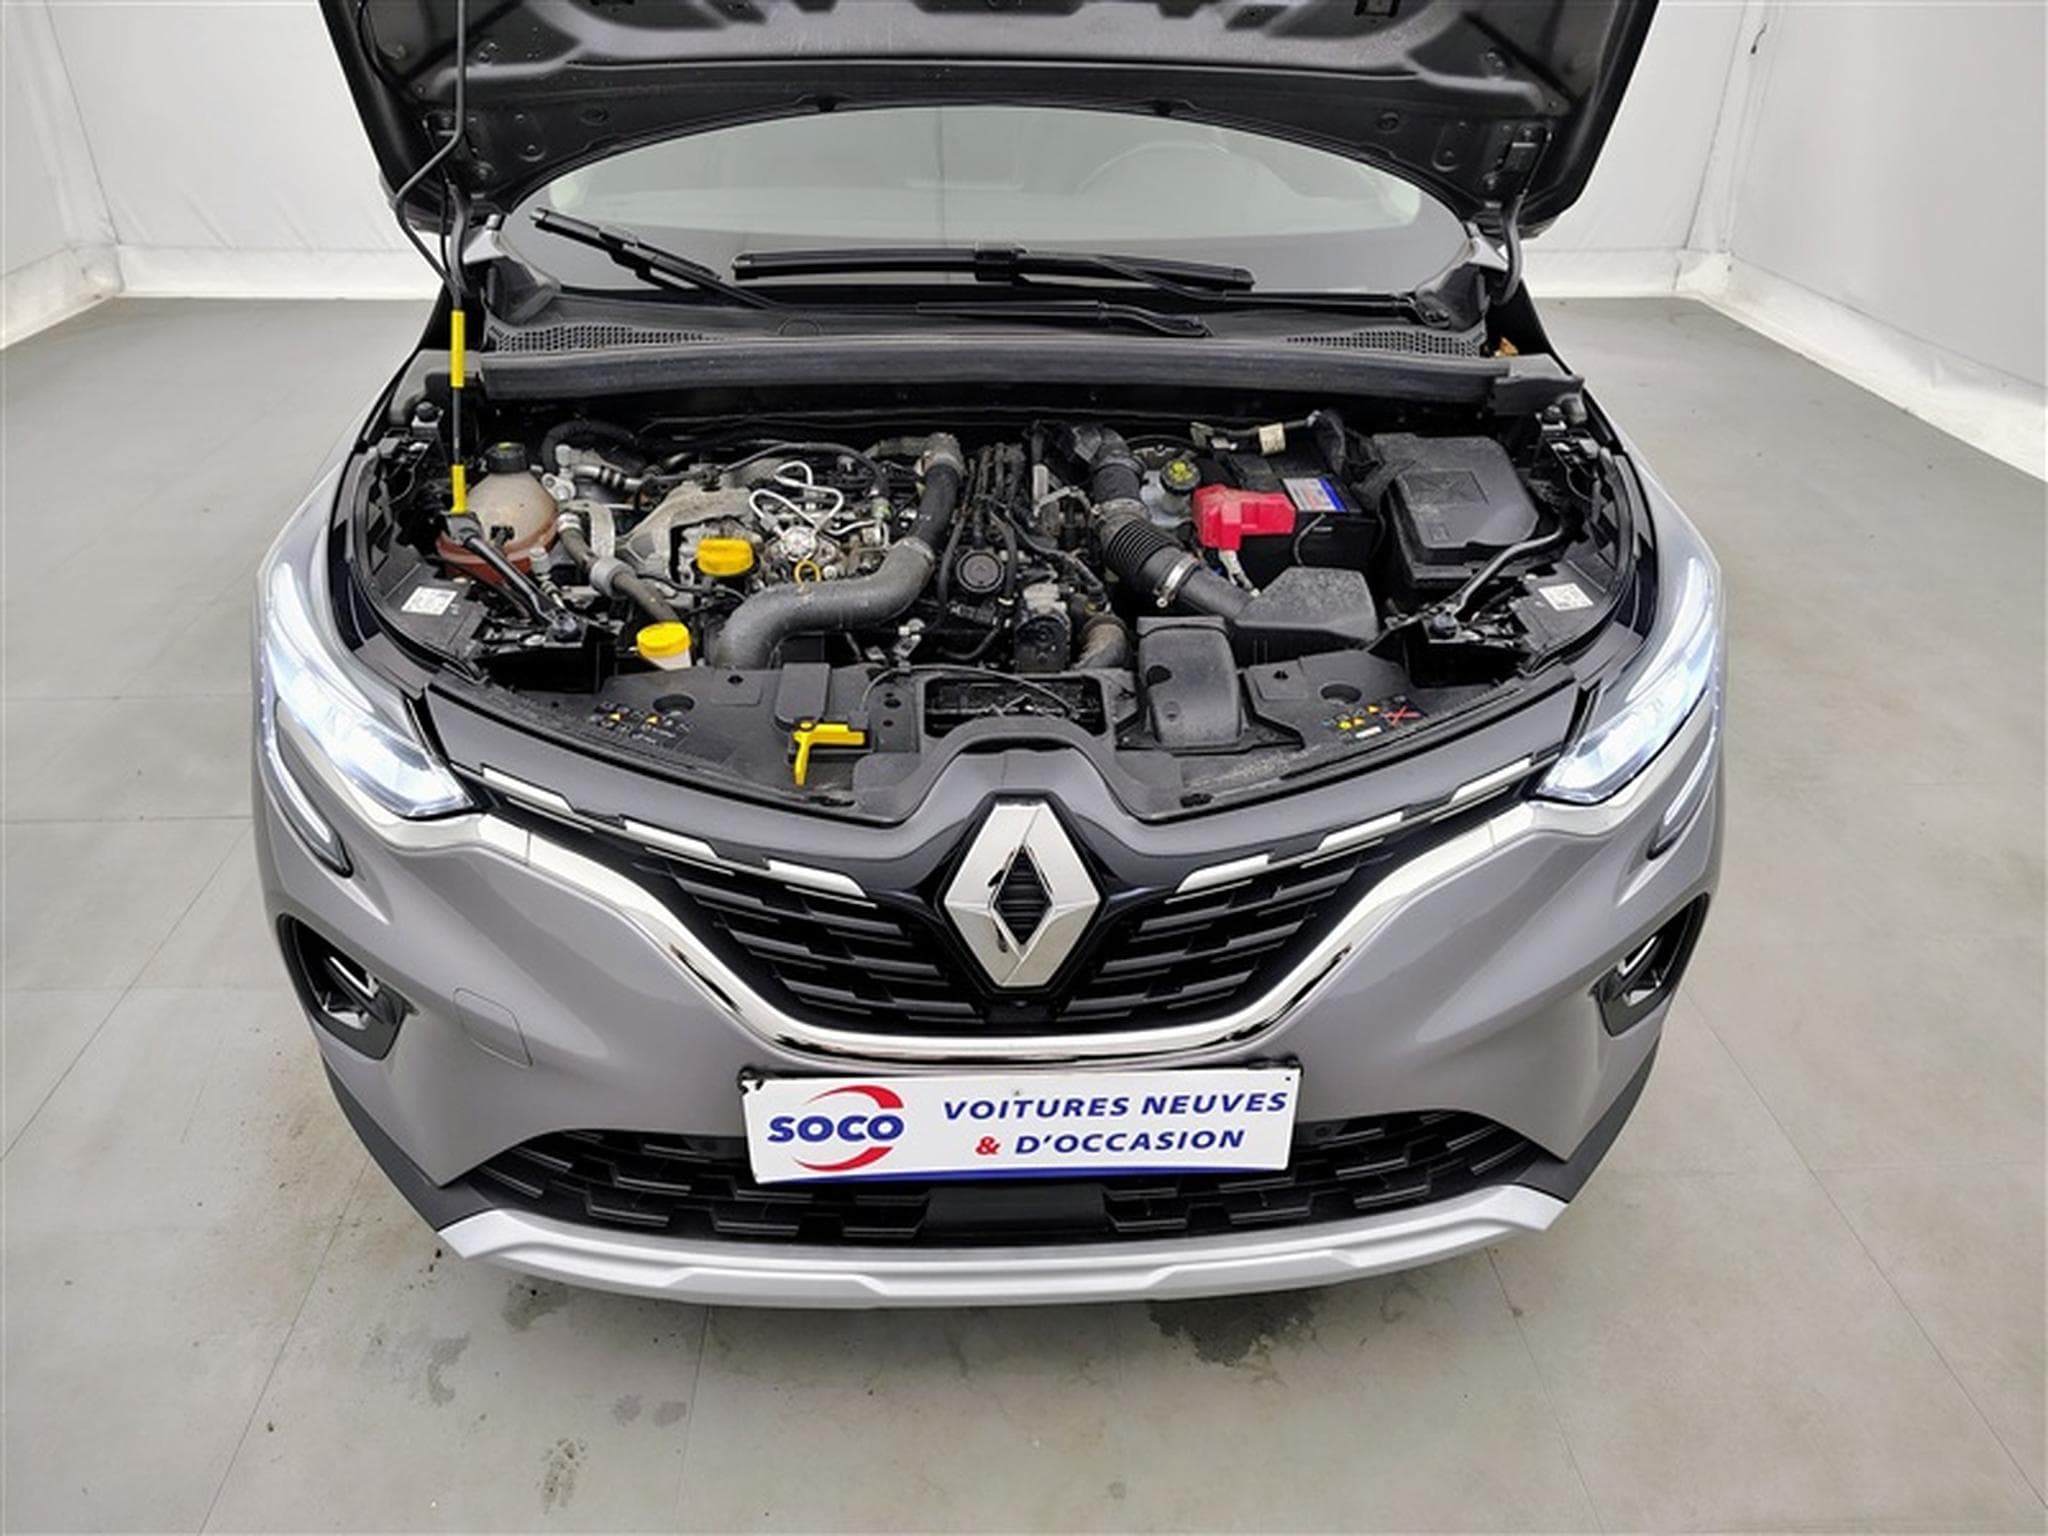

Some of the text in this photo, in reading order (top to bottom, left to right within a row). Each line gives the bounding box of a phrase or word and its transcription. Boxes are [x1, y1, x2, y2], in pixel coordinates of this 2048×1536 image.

[943, 1093, 1287, 1120] VOITURES NEUVES
[768, 1115, 904, 1142] SOCO
[975, 1130, 1244, 1156] & D'OCCASION
